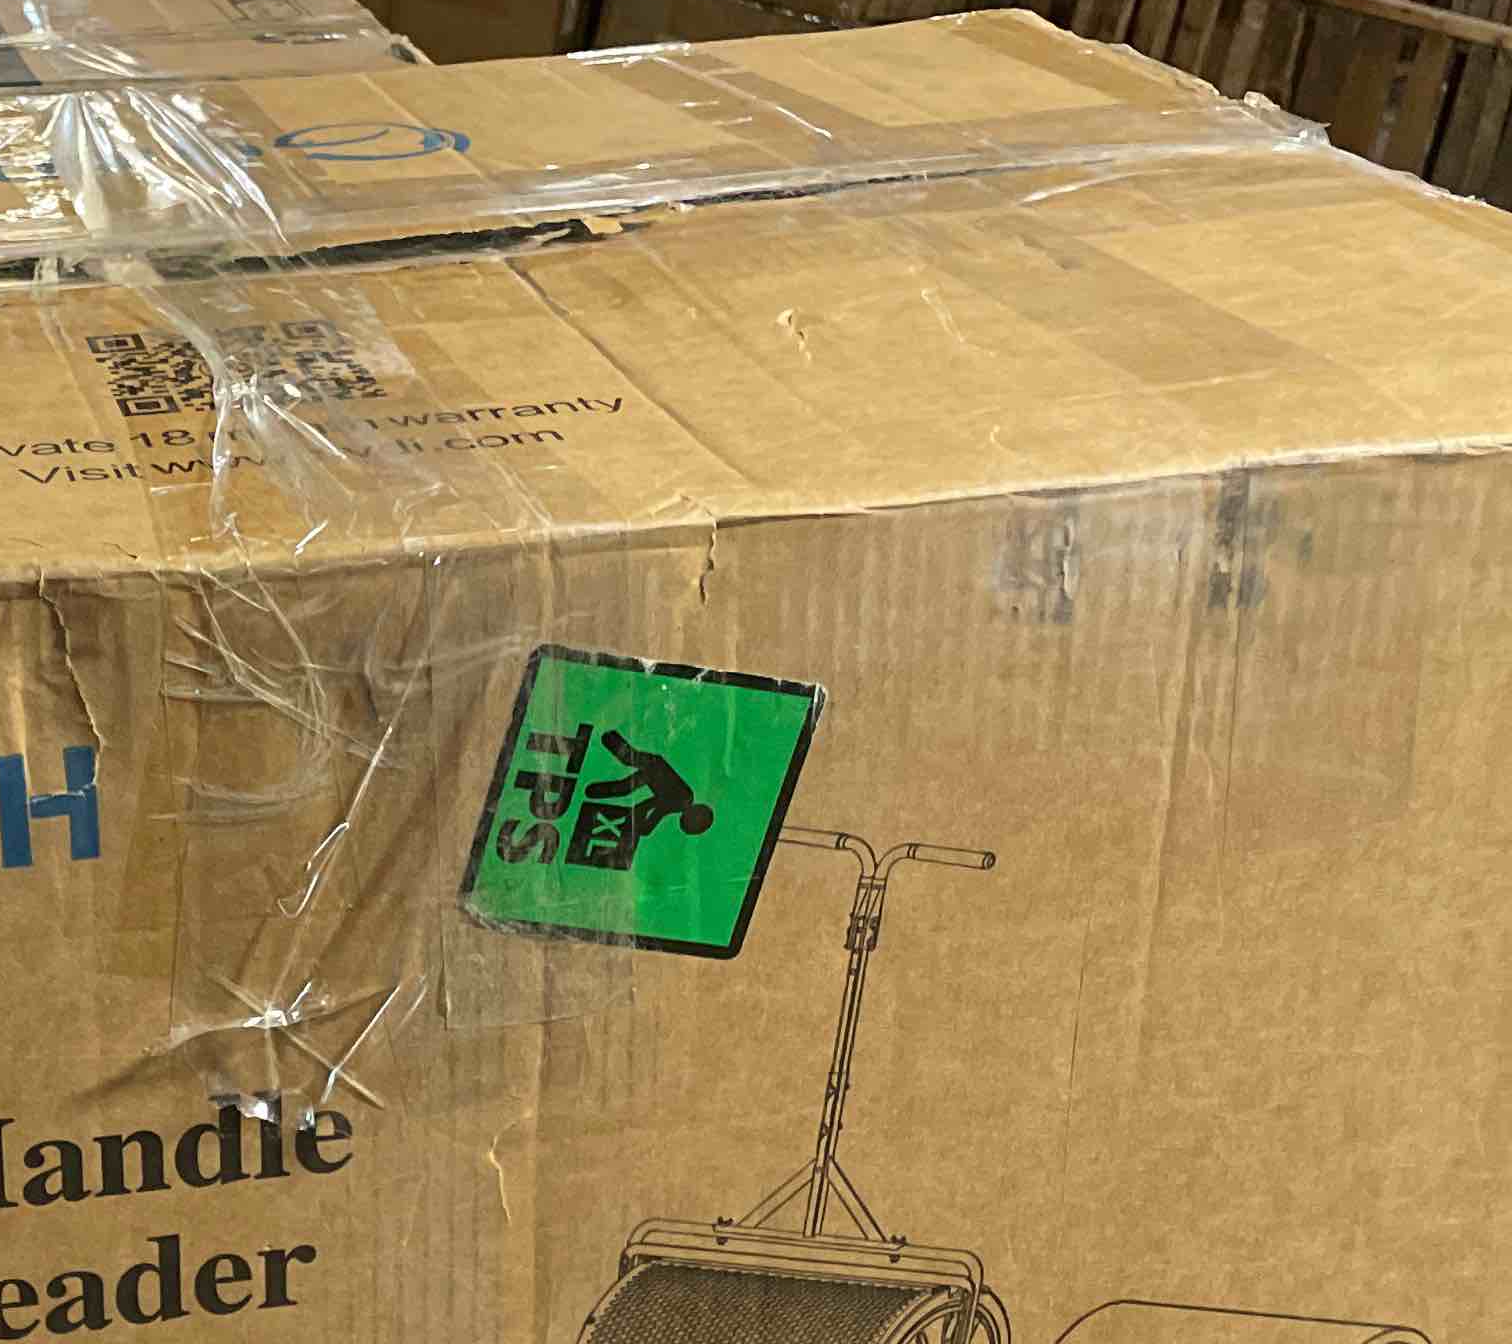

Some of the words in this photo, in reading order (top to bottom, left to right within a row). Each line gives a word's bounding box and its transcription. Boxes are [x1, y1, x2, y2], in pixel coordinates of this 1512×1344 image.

[129, 429, 195, 449] 18
[389, 396, 624, 428] warranty
[17, 462, 144, 485] Visit
[495, 722, 595, 866] TPS
[584, 811, 628, 860] XL
